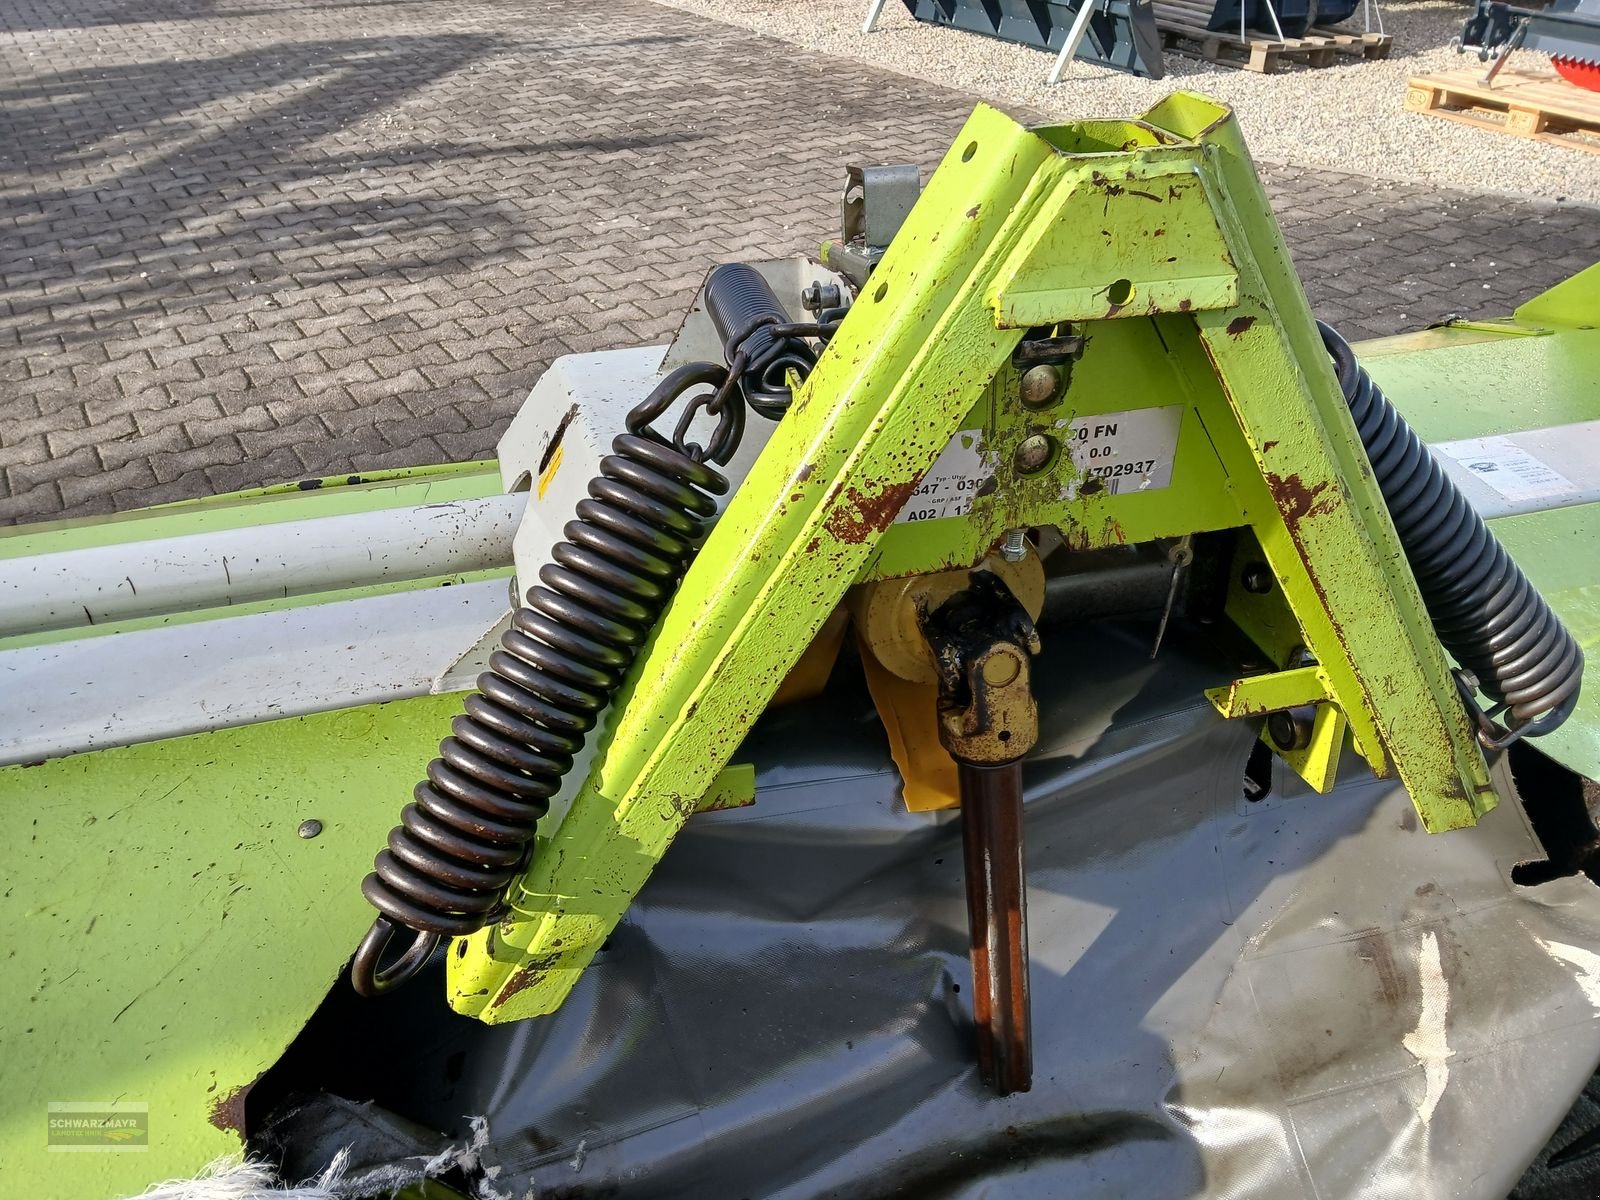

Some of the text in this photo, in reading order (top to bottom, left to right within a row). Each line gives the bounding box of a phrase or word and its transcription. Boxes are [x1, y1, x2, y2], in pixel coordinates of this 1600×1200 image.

[1094, 424, 1117, 438] FN
[1089, 446, 1111, 458] 0.0
[907, 509, 937, 521] A02
[941, 507, 946, 517] /
